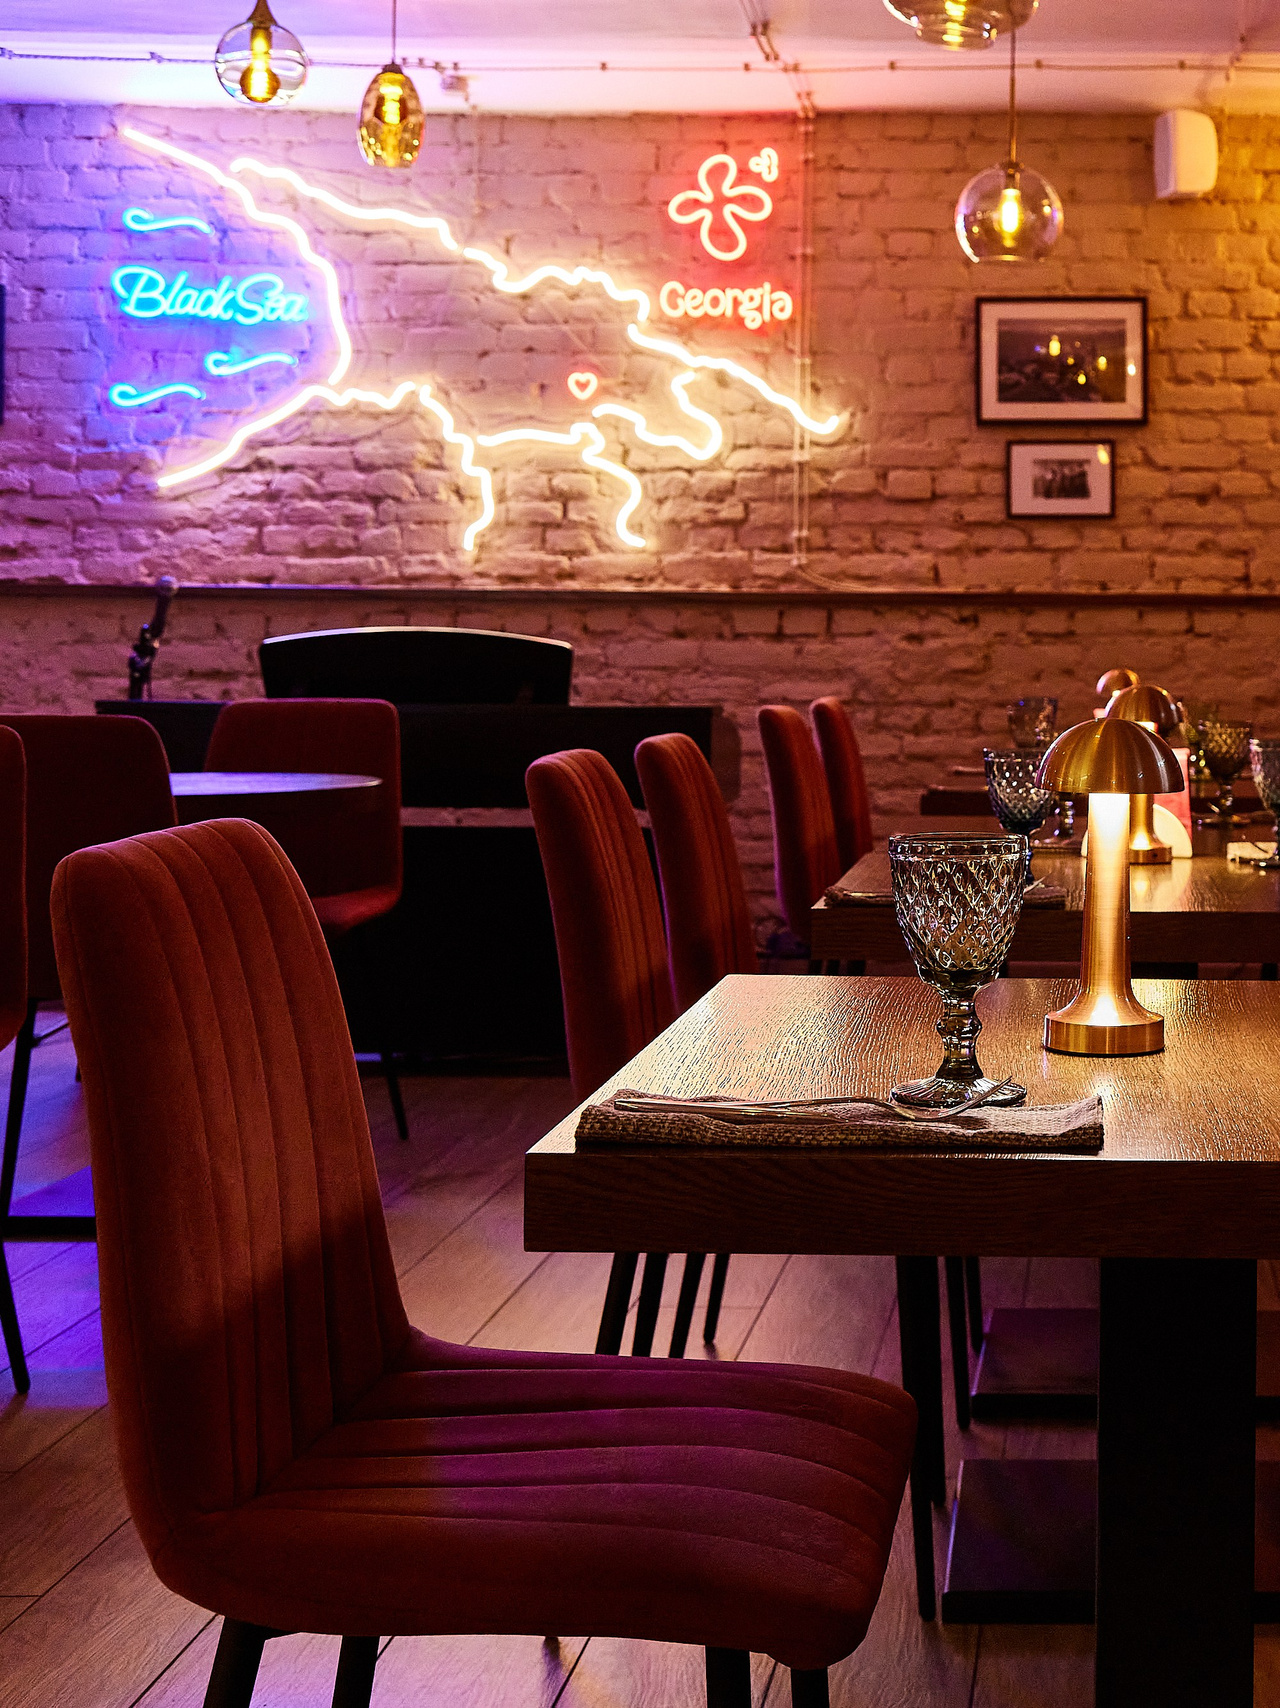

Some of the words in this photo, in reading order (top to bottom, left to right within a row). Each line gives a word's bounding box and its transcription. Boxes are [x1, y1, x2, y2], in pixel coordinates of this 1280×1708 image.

[111, 265, 235, 320] Black
[234, 272, 309, 326] Sea
[659, 280, 793, 330] Georgia
